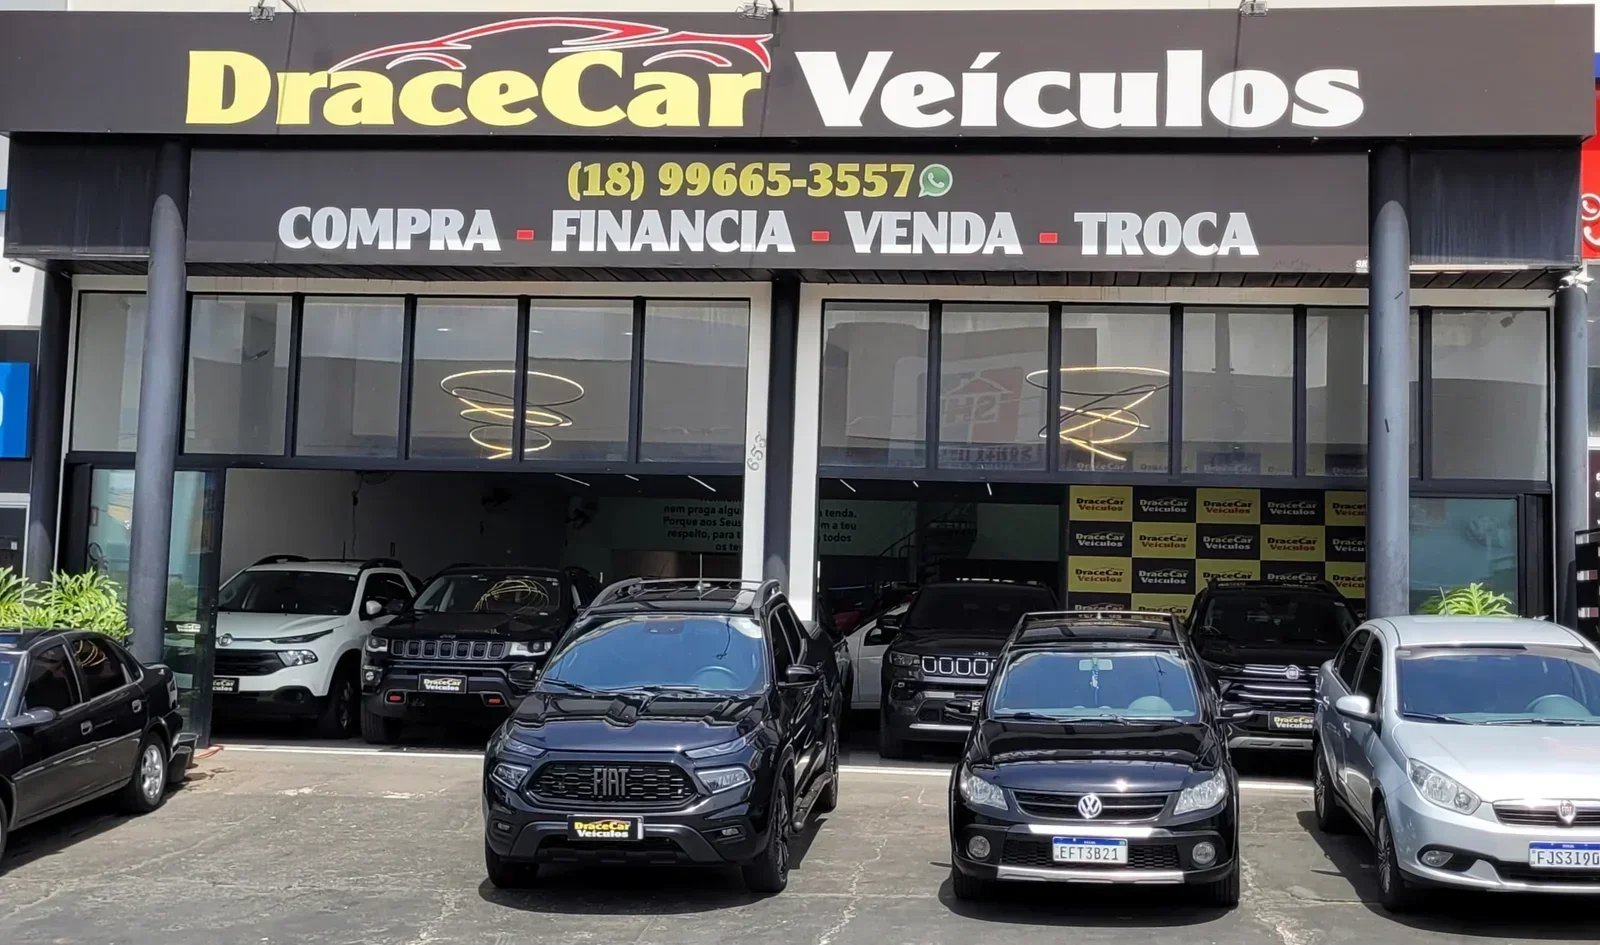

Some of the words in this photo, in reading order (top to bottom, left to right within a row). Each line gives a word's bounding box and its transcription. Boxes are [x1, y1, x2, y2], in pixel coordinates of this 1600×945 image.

[186, 50, 762, 128] DraceCar
[795, 49, 1364, 128] Veículos
[567, 161, 645, 201] (18)
[658, 162, 915, 197] 99665-3557
[278, 206, 501, 252] COMPRA
[550, 209, 796, 253] FINANCIA
[844, 210, 1024, 254] VENDA
[1074, 211, 1259, 256] TROCA
[1076, 498, 1124, 506] DraceCar
[1139, 499, 1188, 507] DraceCar
[1203, 500, 1253, 508] DraceCar
[1267, 501, 1317, 509] DraceCar
[718, 505, 740, 516] algu
[663, 516, 698, 527] Porque
[1075, 533, 1124, 541] DraceCar
[1139, 534, 1188, 542] DraceCar
[1203, 536, 1253, 544] DraceCar
[1267, 537, 1318, 545] DraceCar
[1075, 568, 1124, 577] DraceCar
[1138, 570, 1188, 578] DraceCar
[593, 767, 629, 796] FIAT
[574, 820, 630, 831] DraceCar
[1060, 846, 1118, 860] EFT3B21
